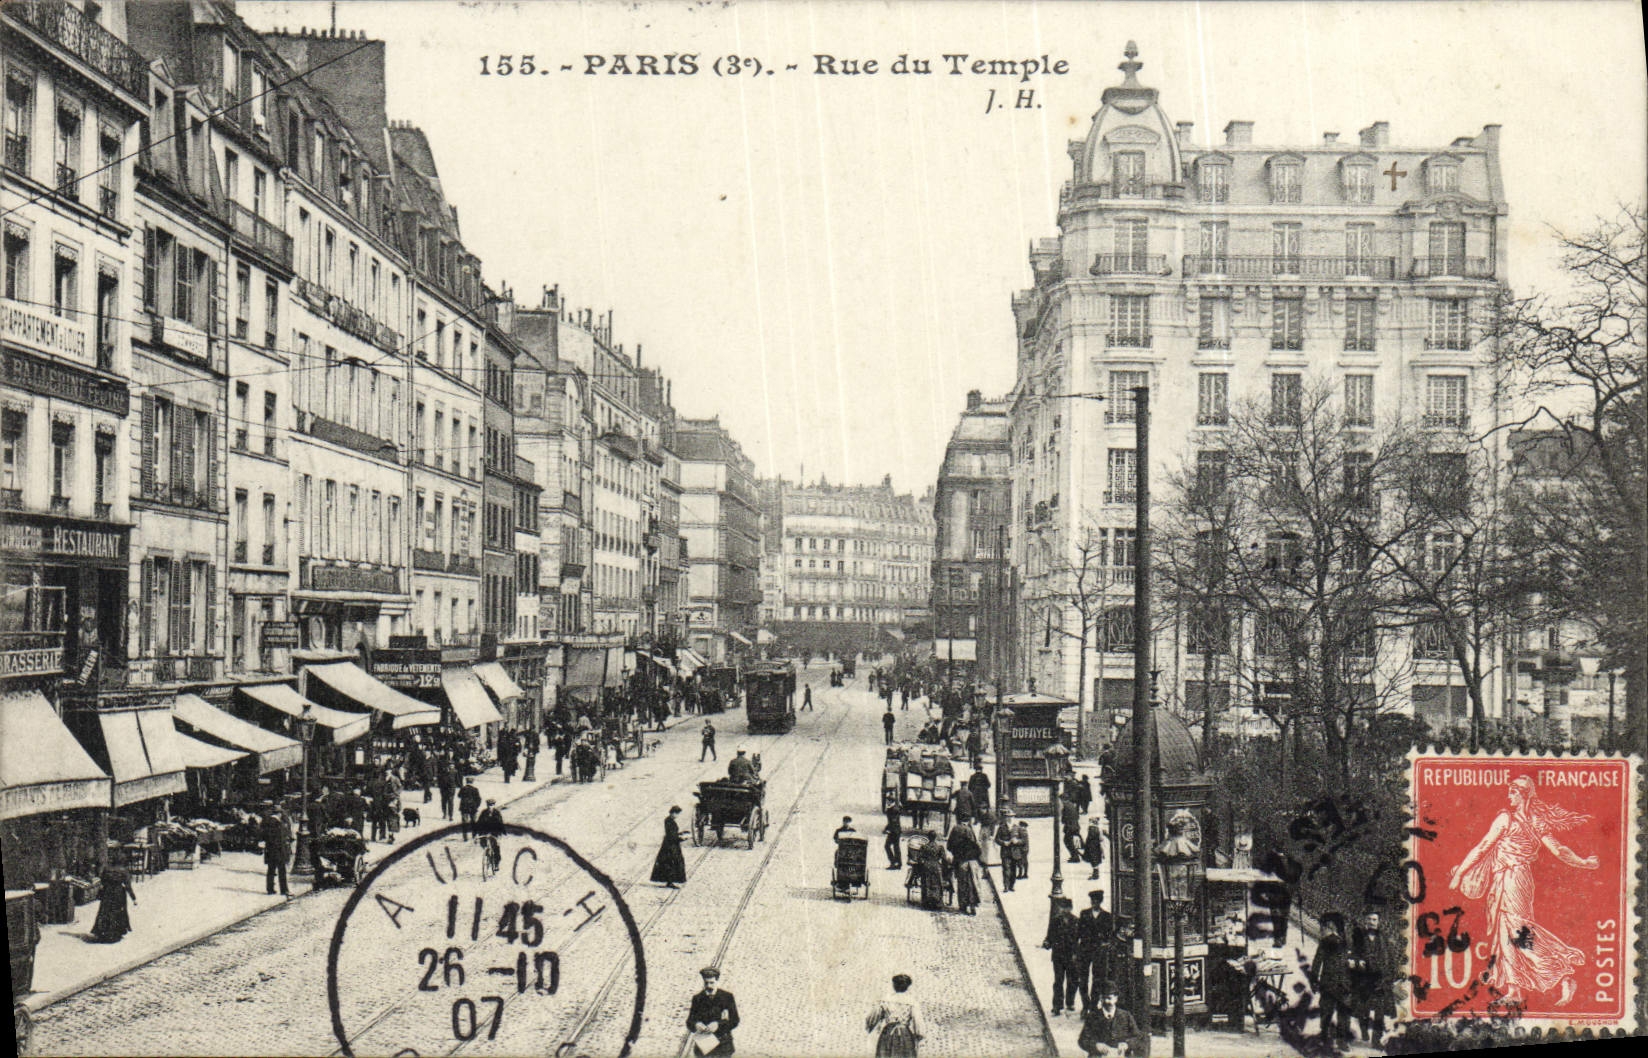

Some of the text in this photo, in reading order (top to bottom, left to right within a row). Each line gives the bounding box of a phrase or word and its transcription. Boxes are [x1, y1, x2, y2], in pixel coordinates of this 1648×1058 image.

[53, 525, 121, 558] RESTAURANT
[1424, 768, 1619, 789] REPUBLIQUE FRANÇAISE
[1595, 919, 1616, 1003] POSTES
